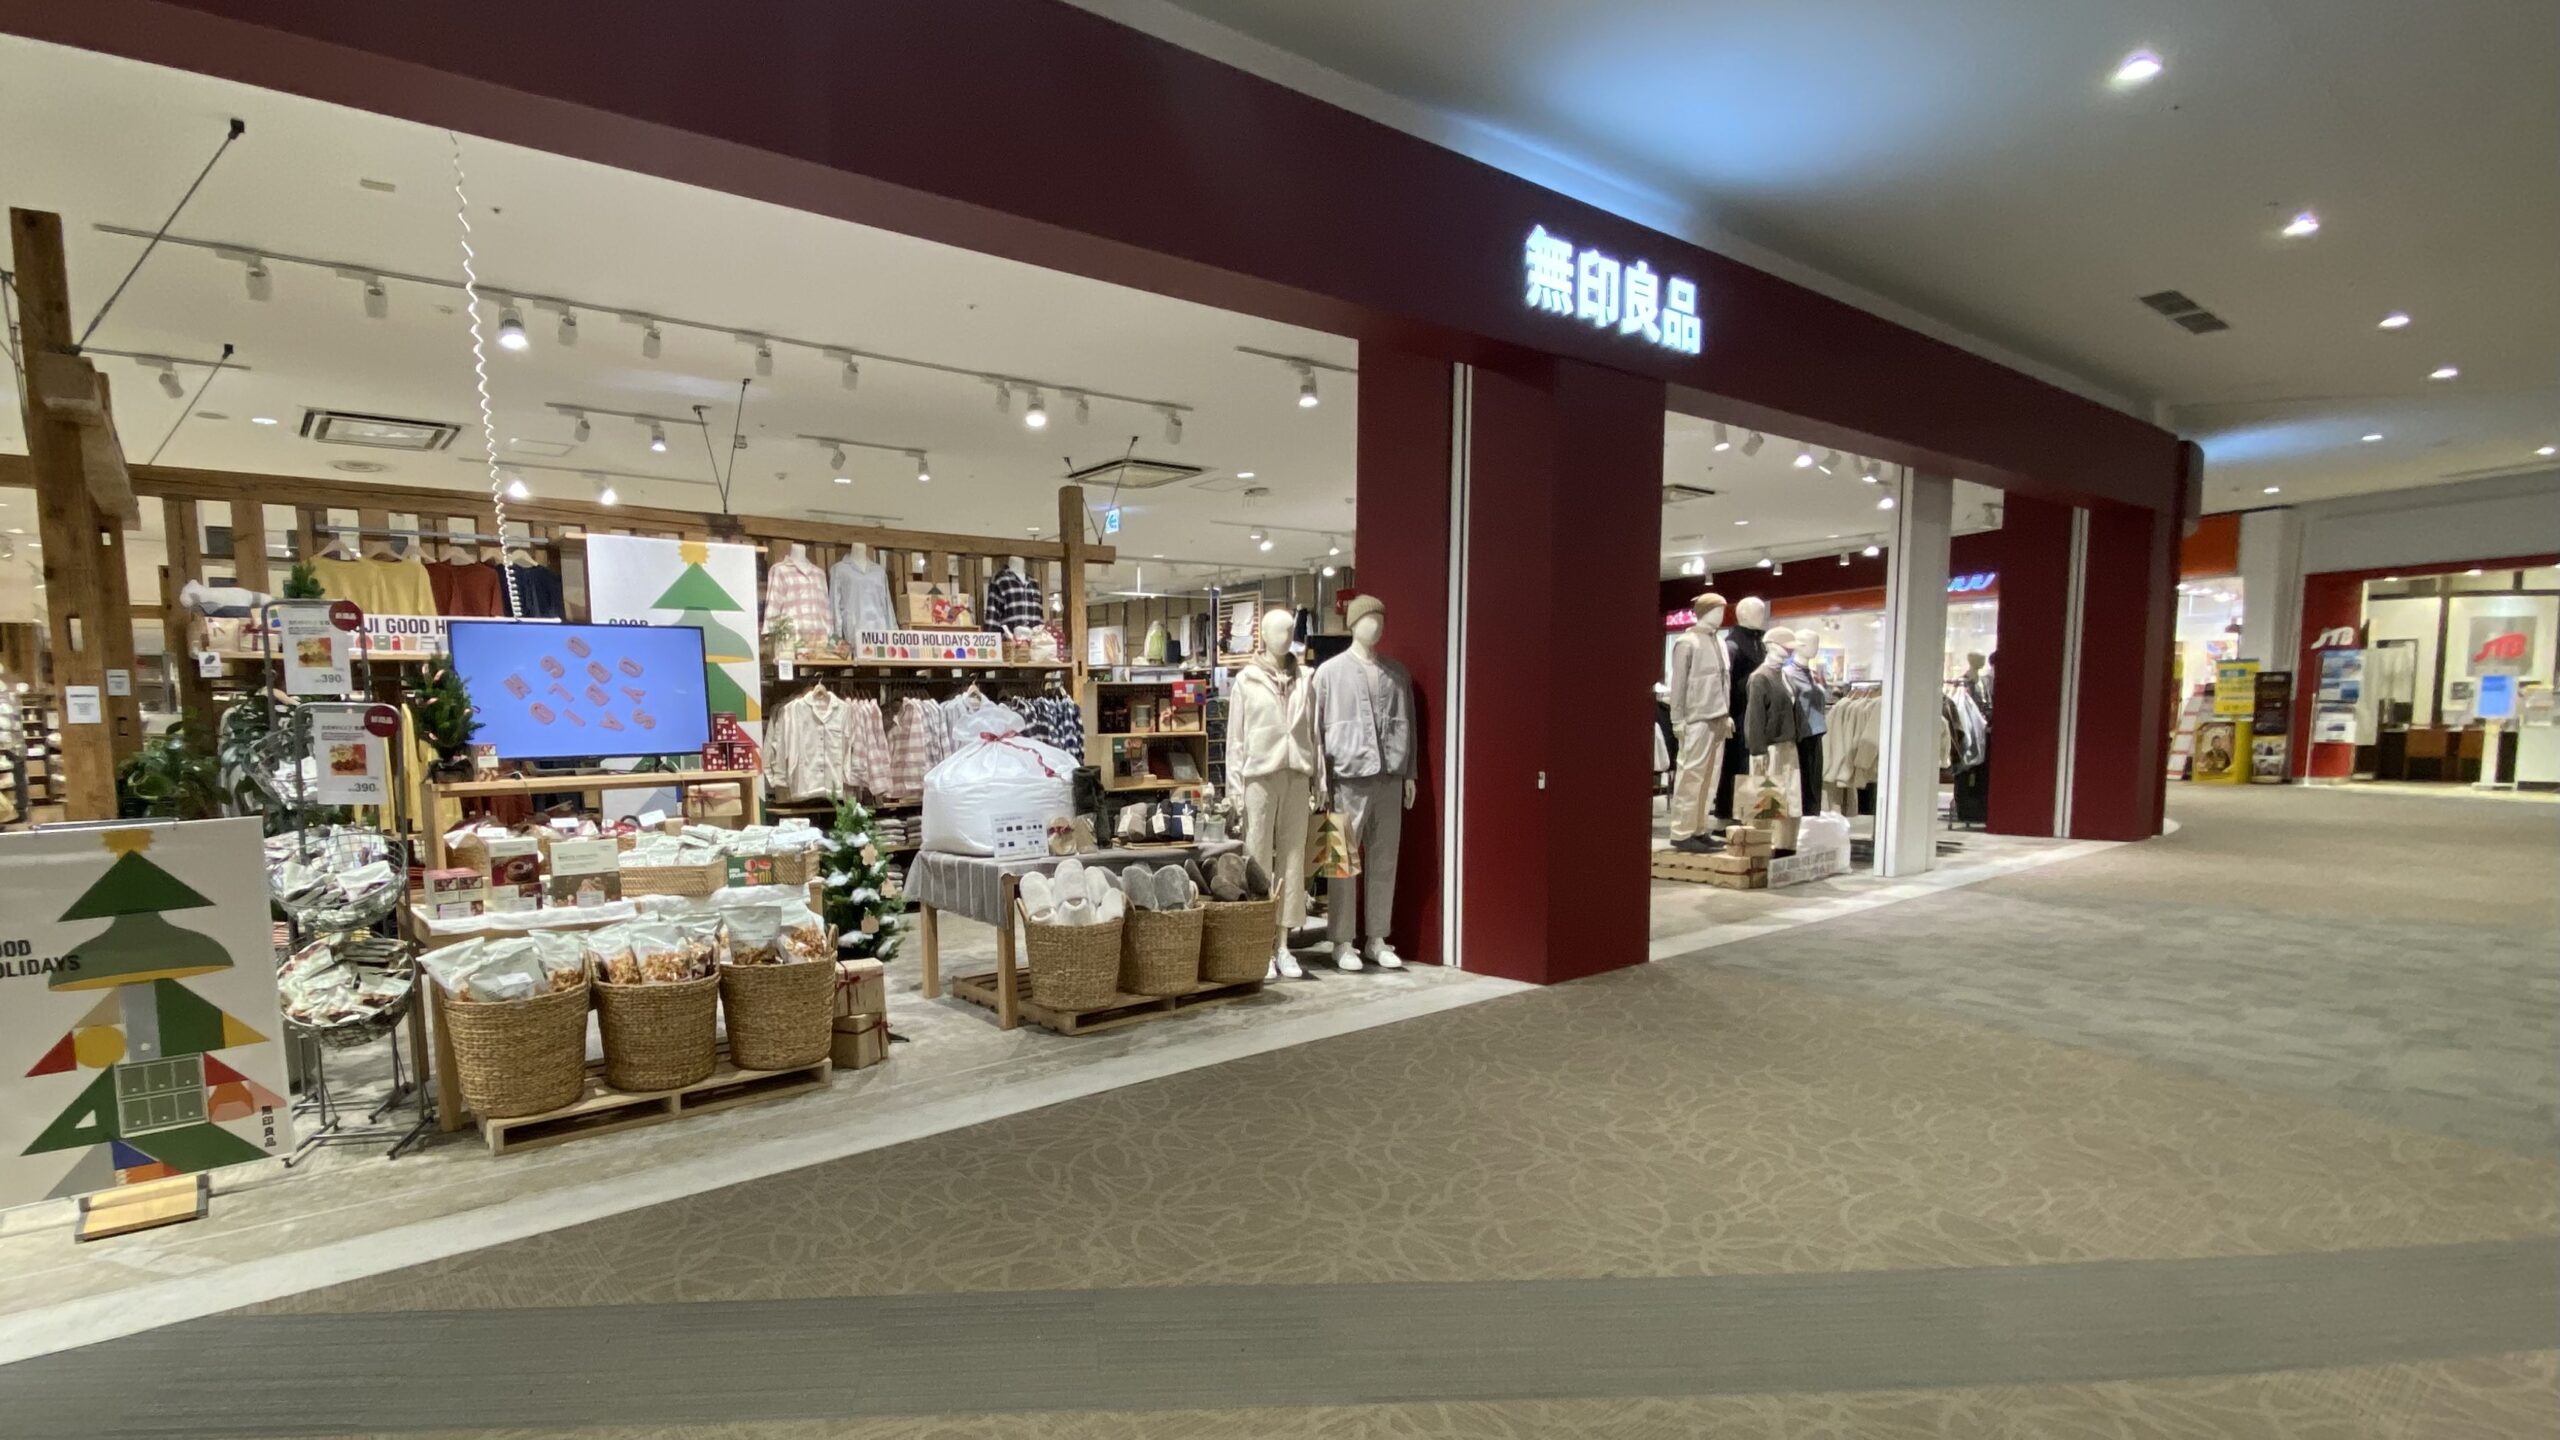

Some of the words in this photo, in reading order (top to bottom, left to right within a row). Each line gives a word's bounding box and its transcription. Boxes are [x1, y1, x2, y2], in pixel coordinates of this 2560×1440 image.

[1526, 224, 1701, 354] 無印良品
[386, 618, 430, 634] GOOD
[861, 632, 889, 645] MUJI
[892, 632, 919, 646] GOOD
[922, 633, 970, 647] HOLIDAYS
[973, 634, 996, 646] 2025
[2311, 627, 2354, 649] JTB
[0, 940, 32, 958] OD
